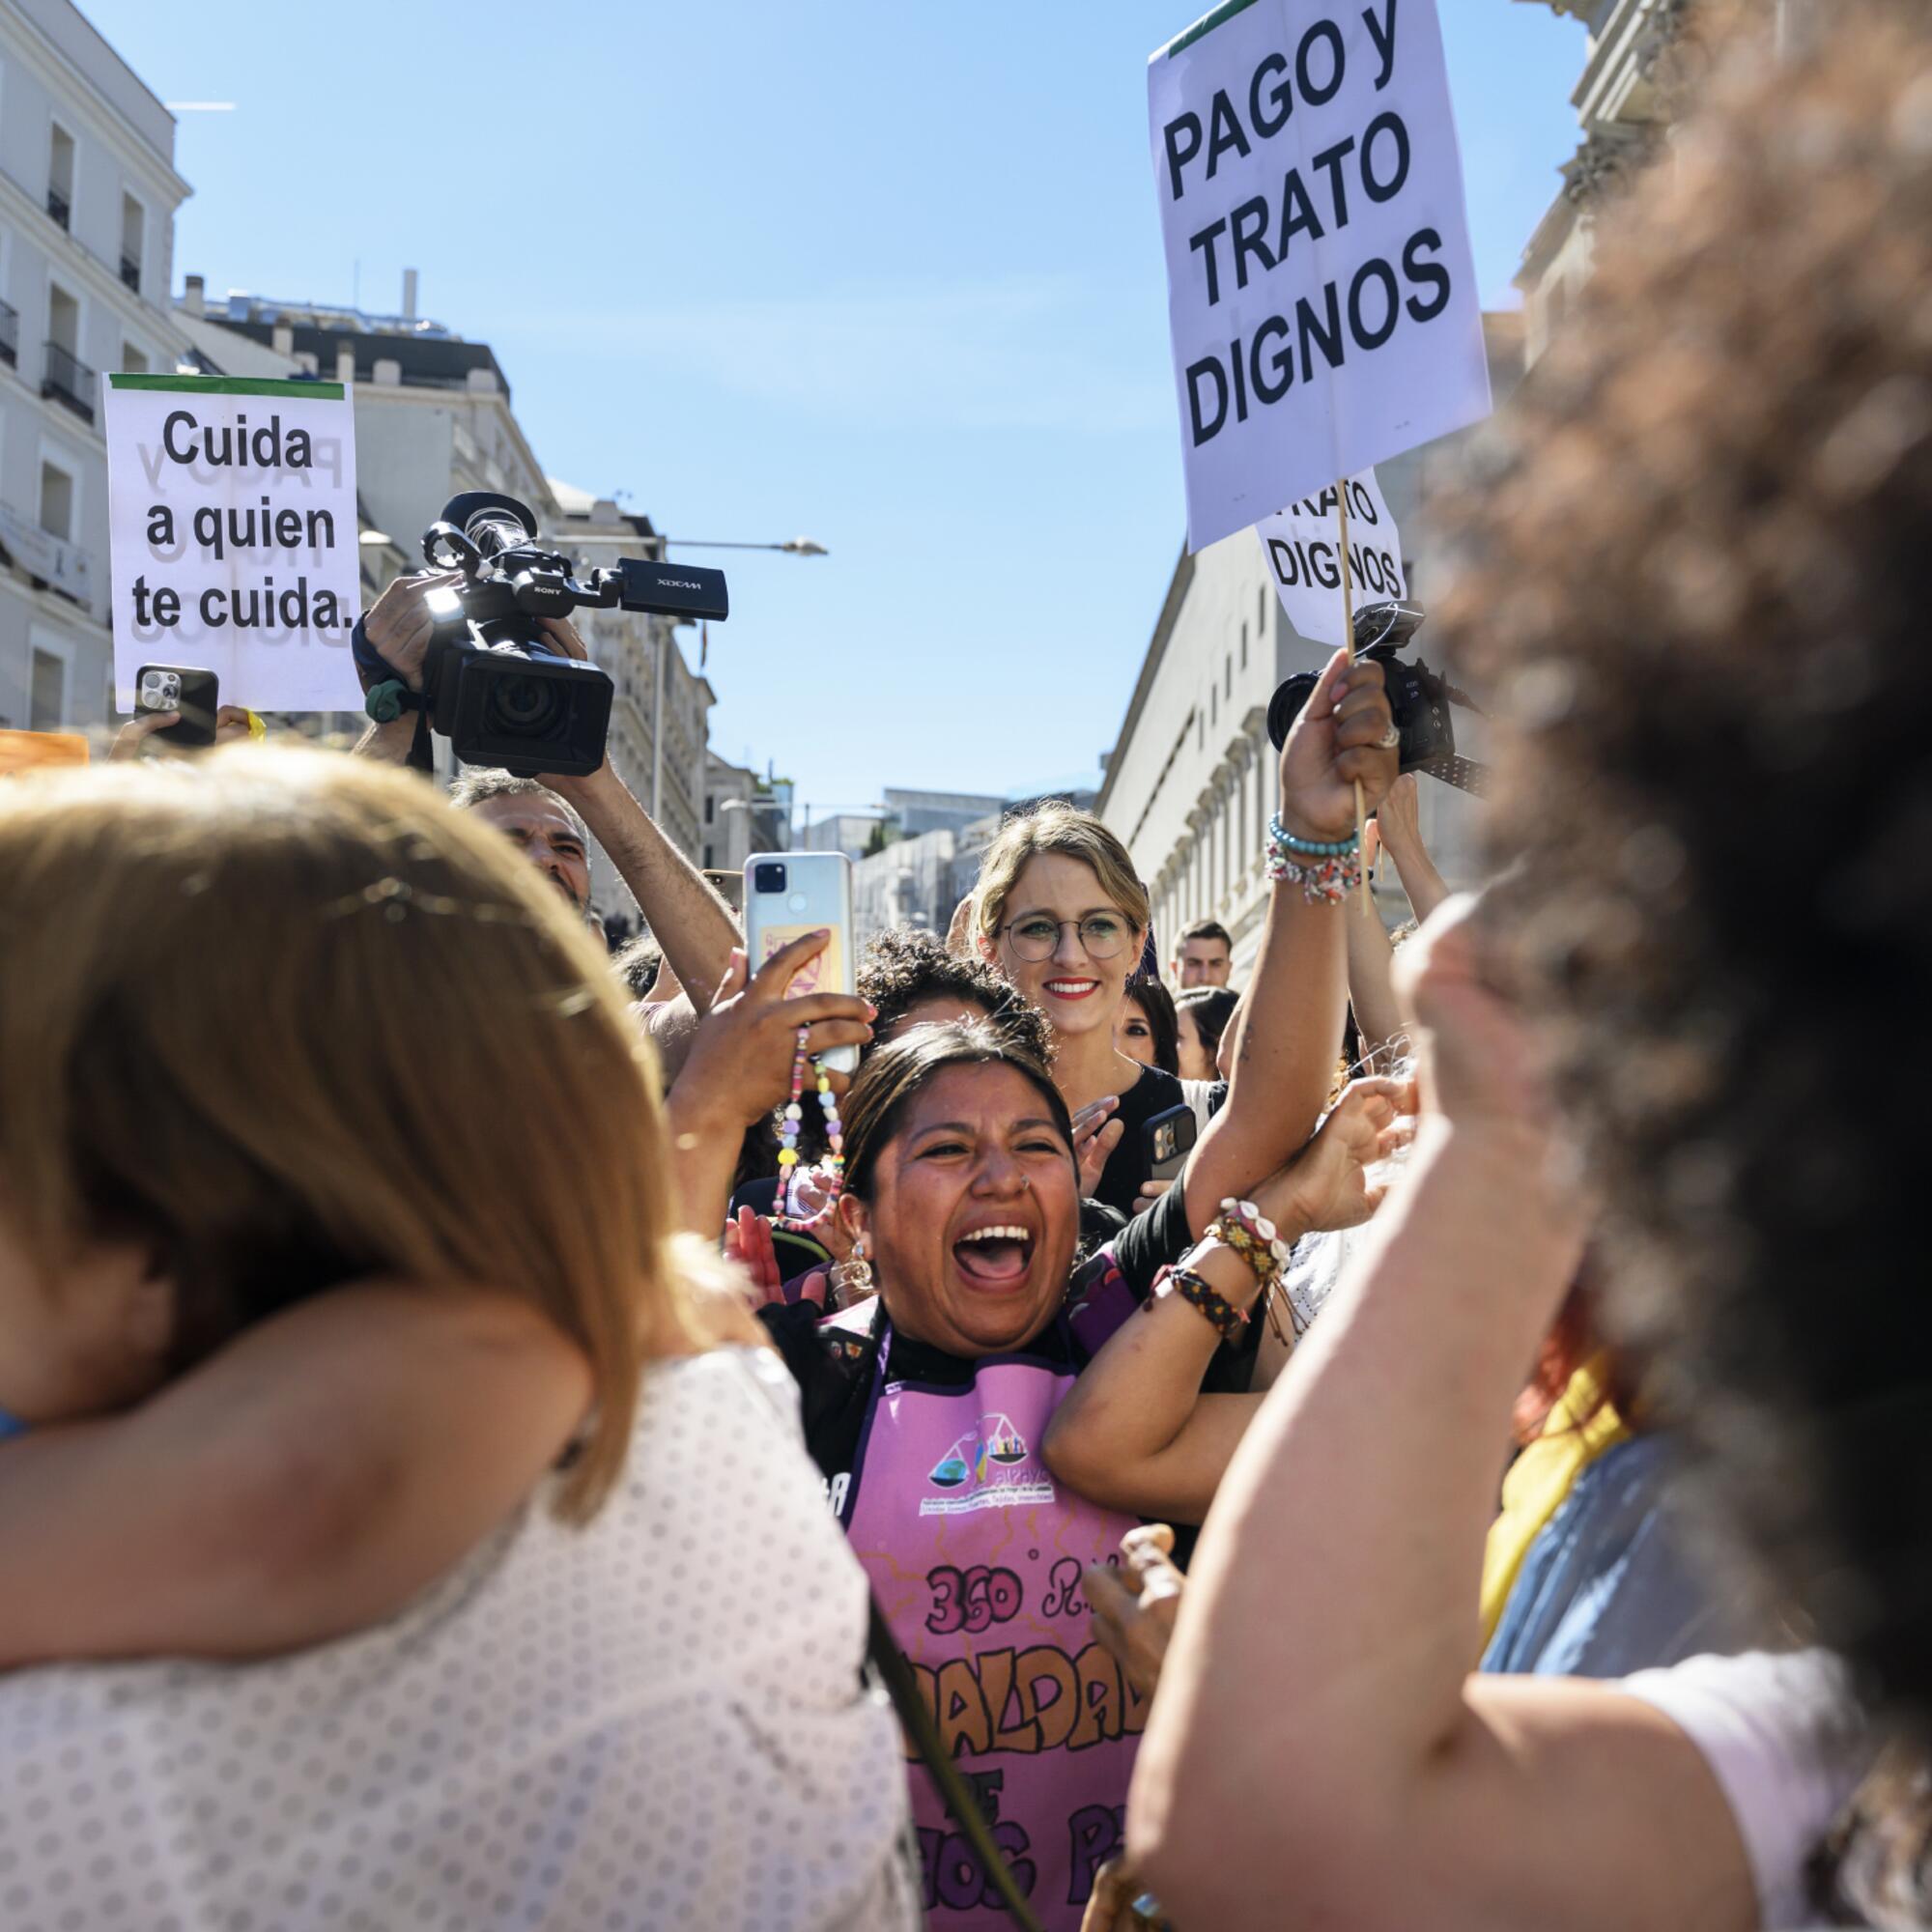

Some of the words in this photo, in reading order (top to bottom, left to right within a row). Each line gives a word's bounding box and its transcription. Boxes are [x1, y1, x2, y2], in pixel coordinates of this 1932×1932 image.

[1163, 19, 1347, 201] PAGO
[1361, 0, 1397, 92] y
[1189, 111, 1410, 307] TRATO
[1185, 227, 1451, 447] DIGNOS
[163, 411, 312, 469] Cuida
[147, 505, 175, 546] a
[193, 496, 335, 560] quien
[533, 585, 562, 595] SONY
[1266, 538, 1402, 600] DIGNOS
[131, 576, 182, 627] te
[199, 576, 353, 629] cuida.
